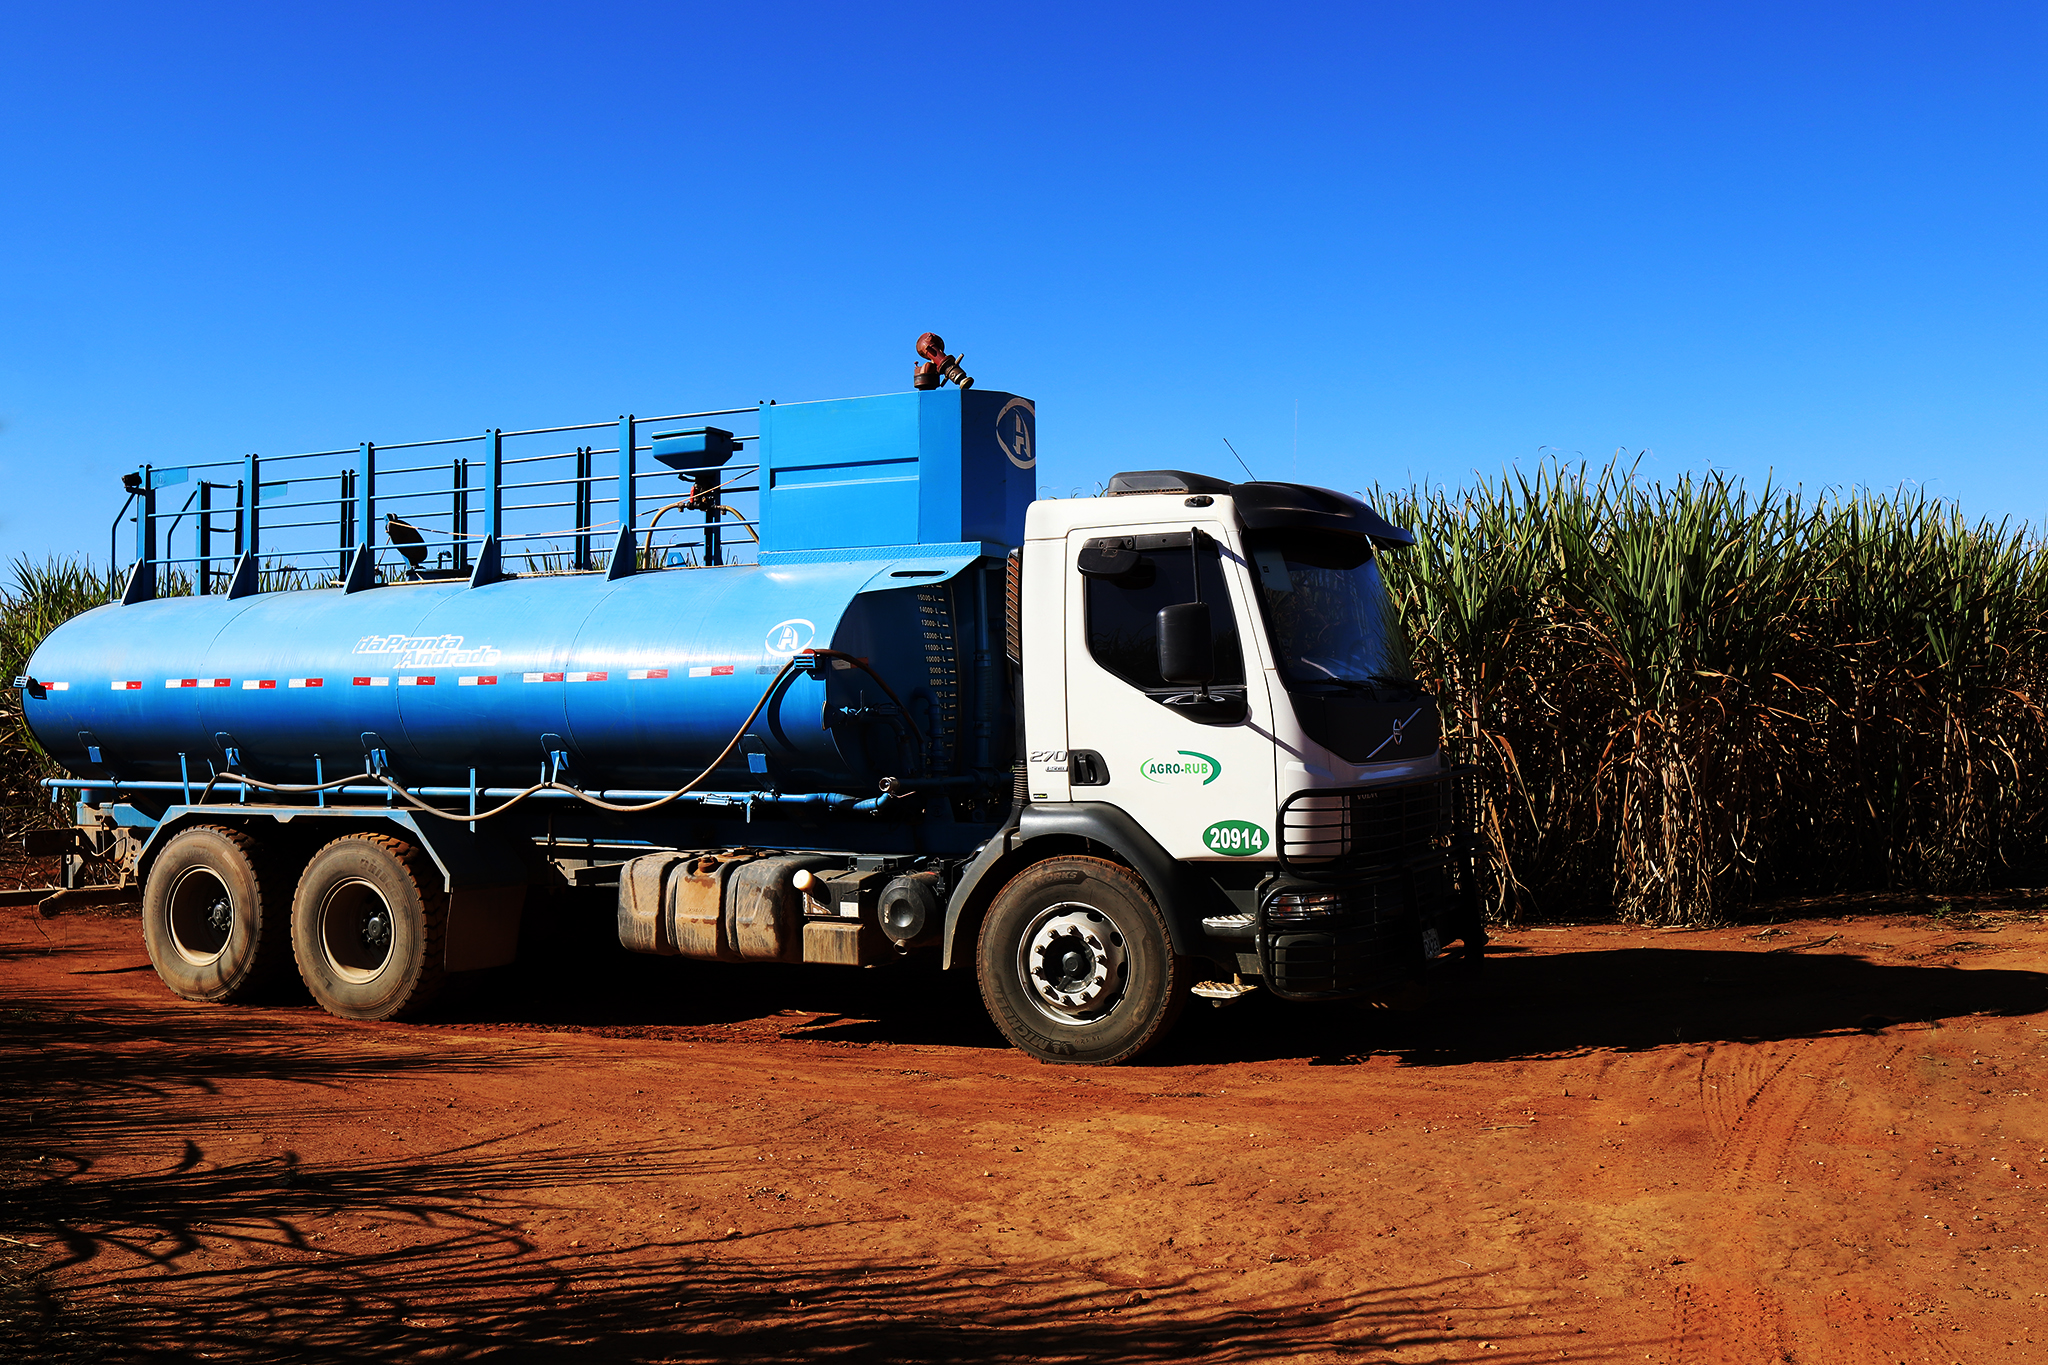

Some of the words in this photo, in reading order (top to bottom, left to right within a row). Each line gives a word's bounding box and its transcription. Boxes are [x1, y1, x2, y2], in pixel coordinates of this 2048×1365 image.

[395, 646, 501, 668] Andrade
[1030, 750, 1068, 762] 270
[1149, 763, 1209, 775] AGRO-RUB
[1209, 827, 1263, 849] 20914
